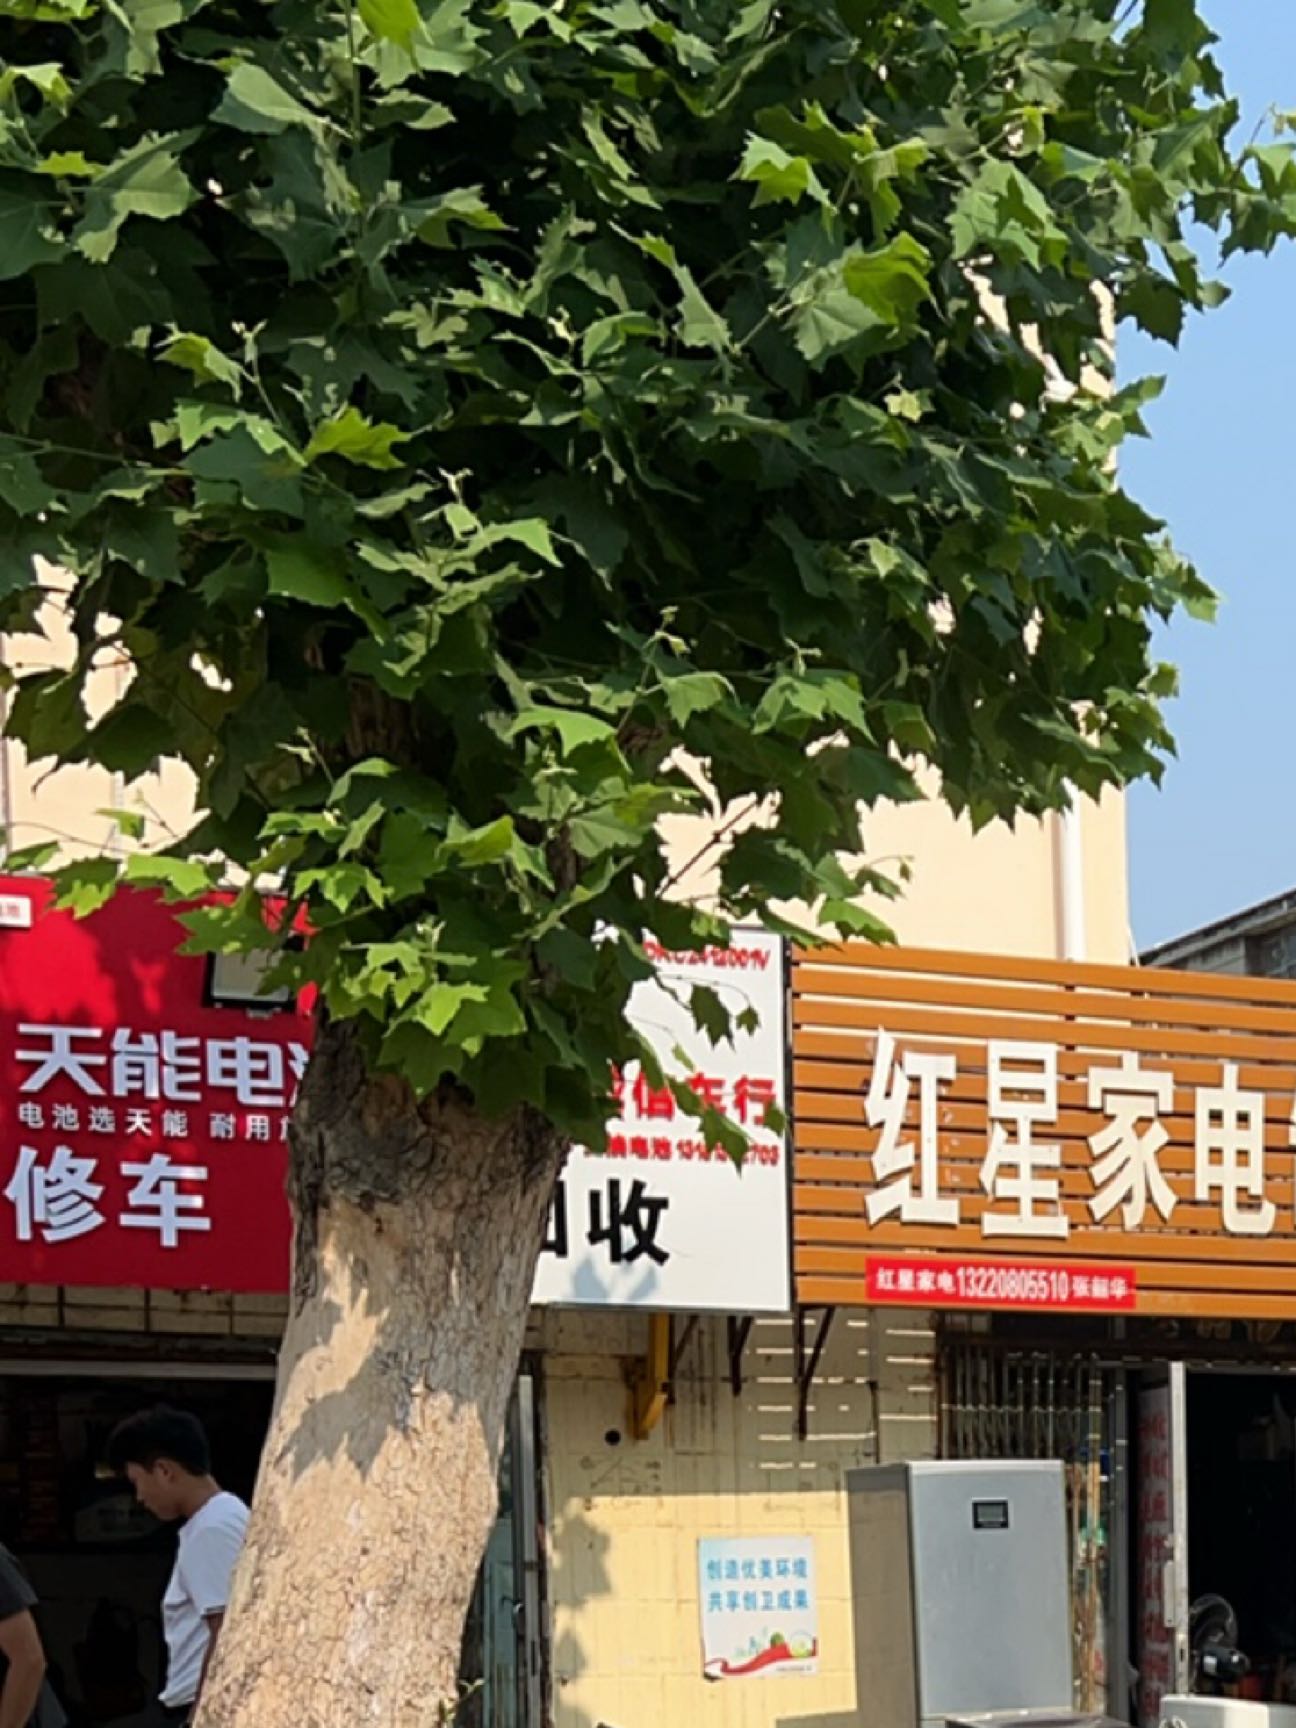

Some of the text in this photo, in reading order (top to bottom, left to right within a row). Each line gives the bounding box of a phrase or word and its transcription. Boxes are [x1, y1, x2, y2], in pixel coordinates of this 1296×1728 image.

[18, 1101, 188, 1138] 电池选天能
[5, 1144, 212, 1248] 修车
